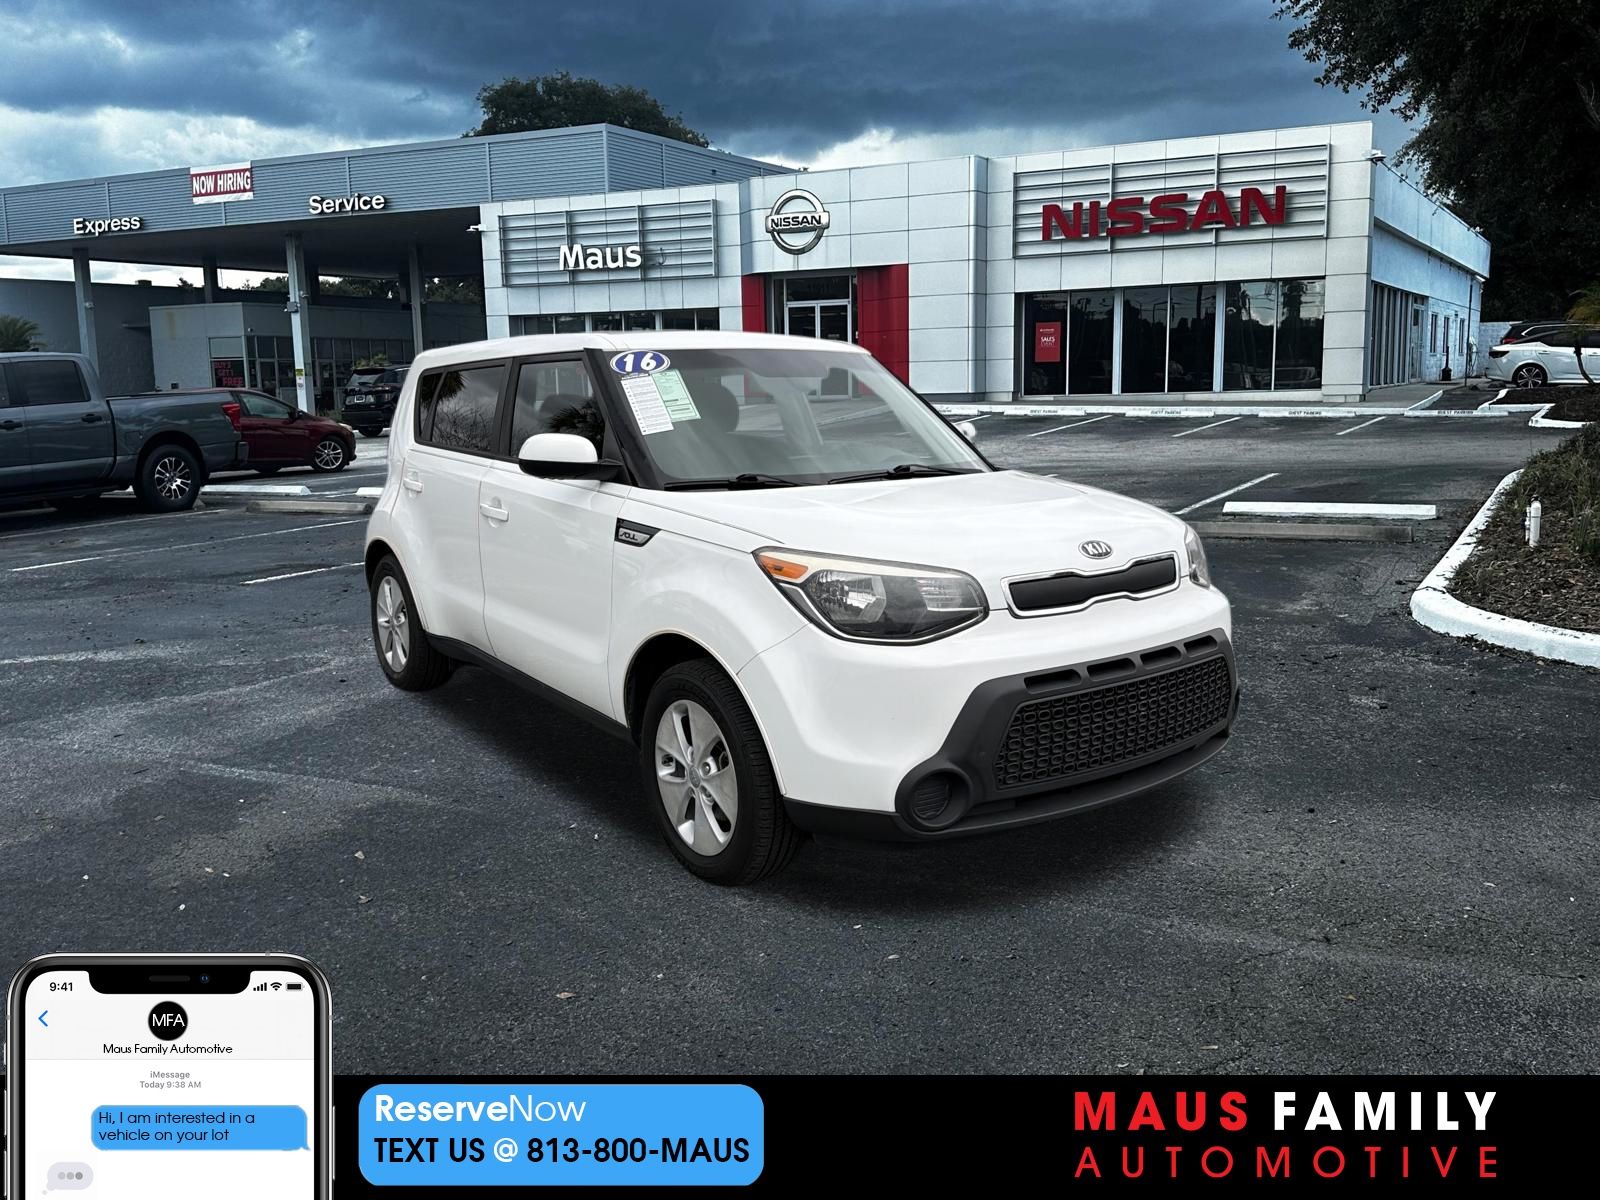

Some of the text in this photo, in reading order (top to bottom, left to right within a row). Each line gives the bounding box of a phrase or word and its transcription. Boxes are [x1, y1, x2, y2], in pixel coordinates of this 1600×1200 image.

[192, 170, 251, 195] NOW HIRING
[308, 193, 385, 215] Service
[1042, 186, 1288, 241] NISSAN
[73, 216, 141, 237] Express
[770, 215, 822, 229] NISSAN
[559, 243, 642, 271] Maus
[623, 352, 657, 373] 16
[223, 377, 244, 386] FREE
[1083, 542, 1111, 555] KIA
